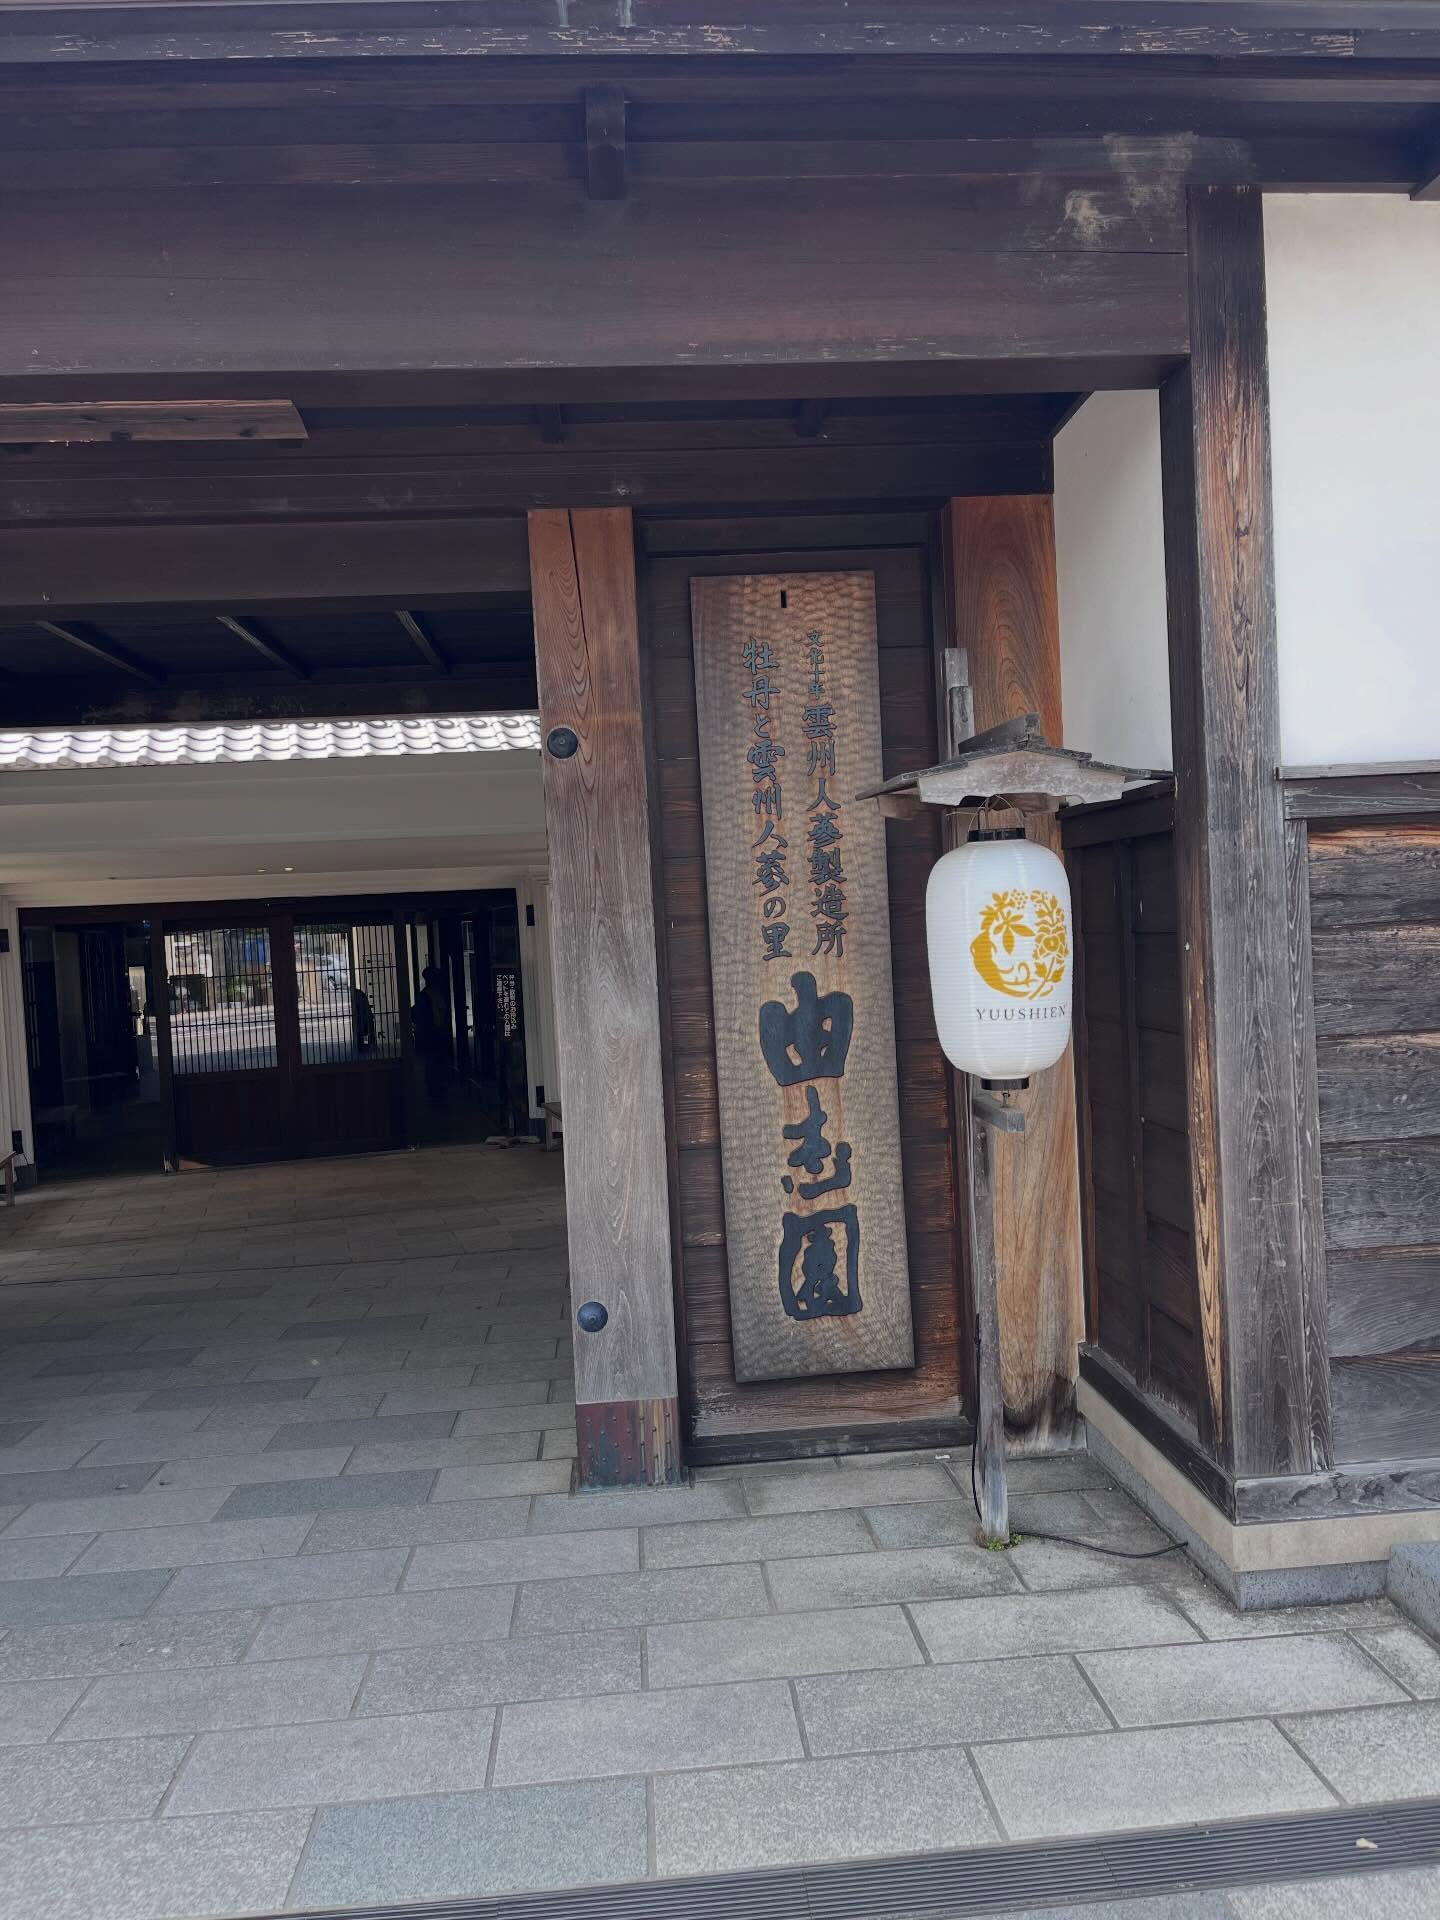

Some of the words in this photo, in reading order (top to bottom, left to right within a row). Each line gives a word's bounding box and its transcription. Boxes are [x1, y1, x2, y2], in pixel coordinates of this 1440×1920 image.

[976, 1004, 1066, 1021] YUUSHIEN
[759, 971, 863, 1320] 由志園
